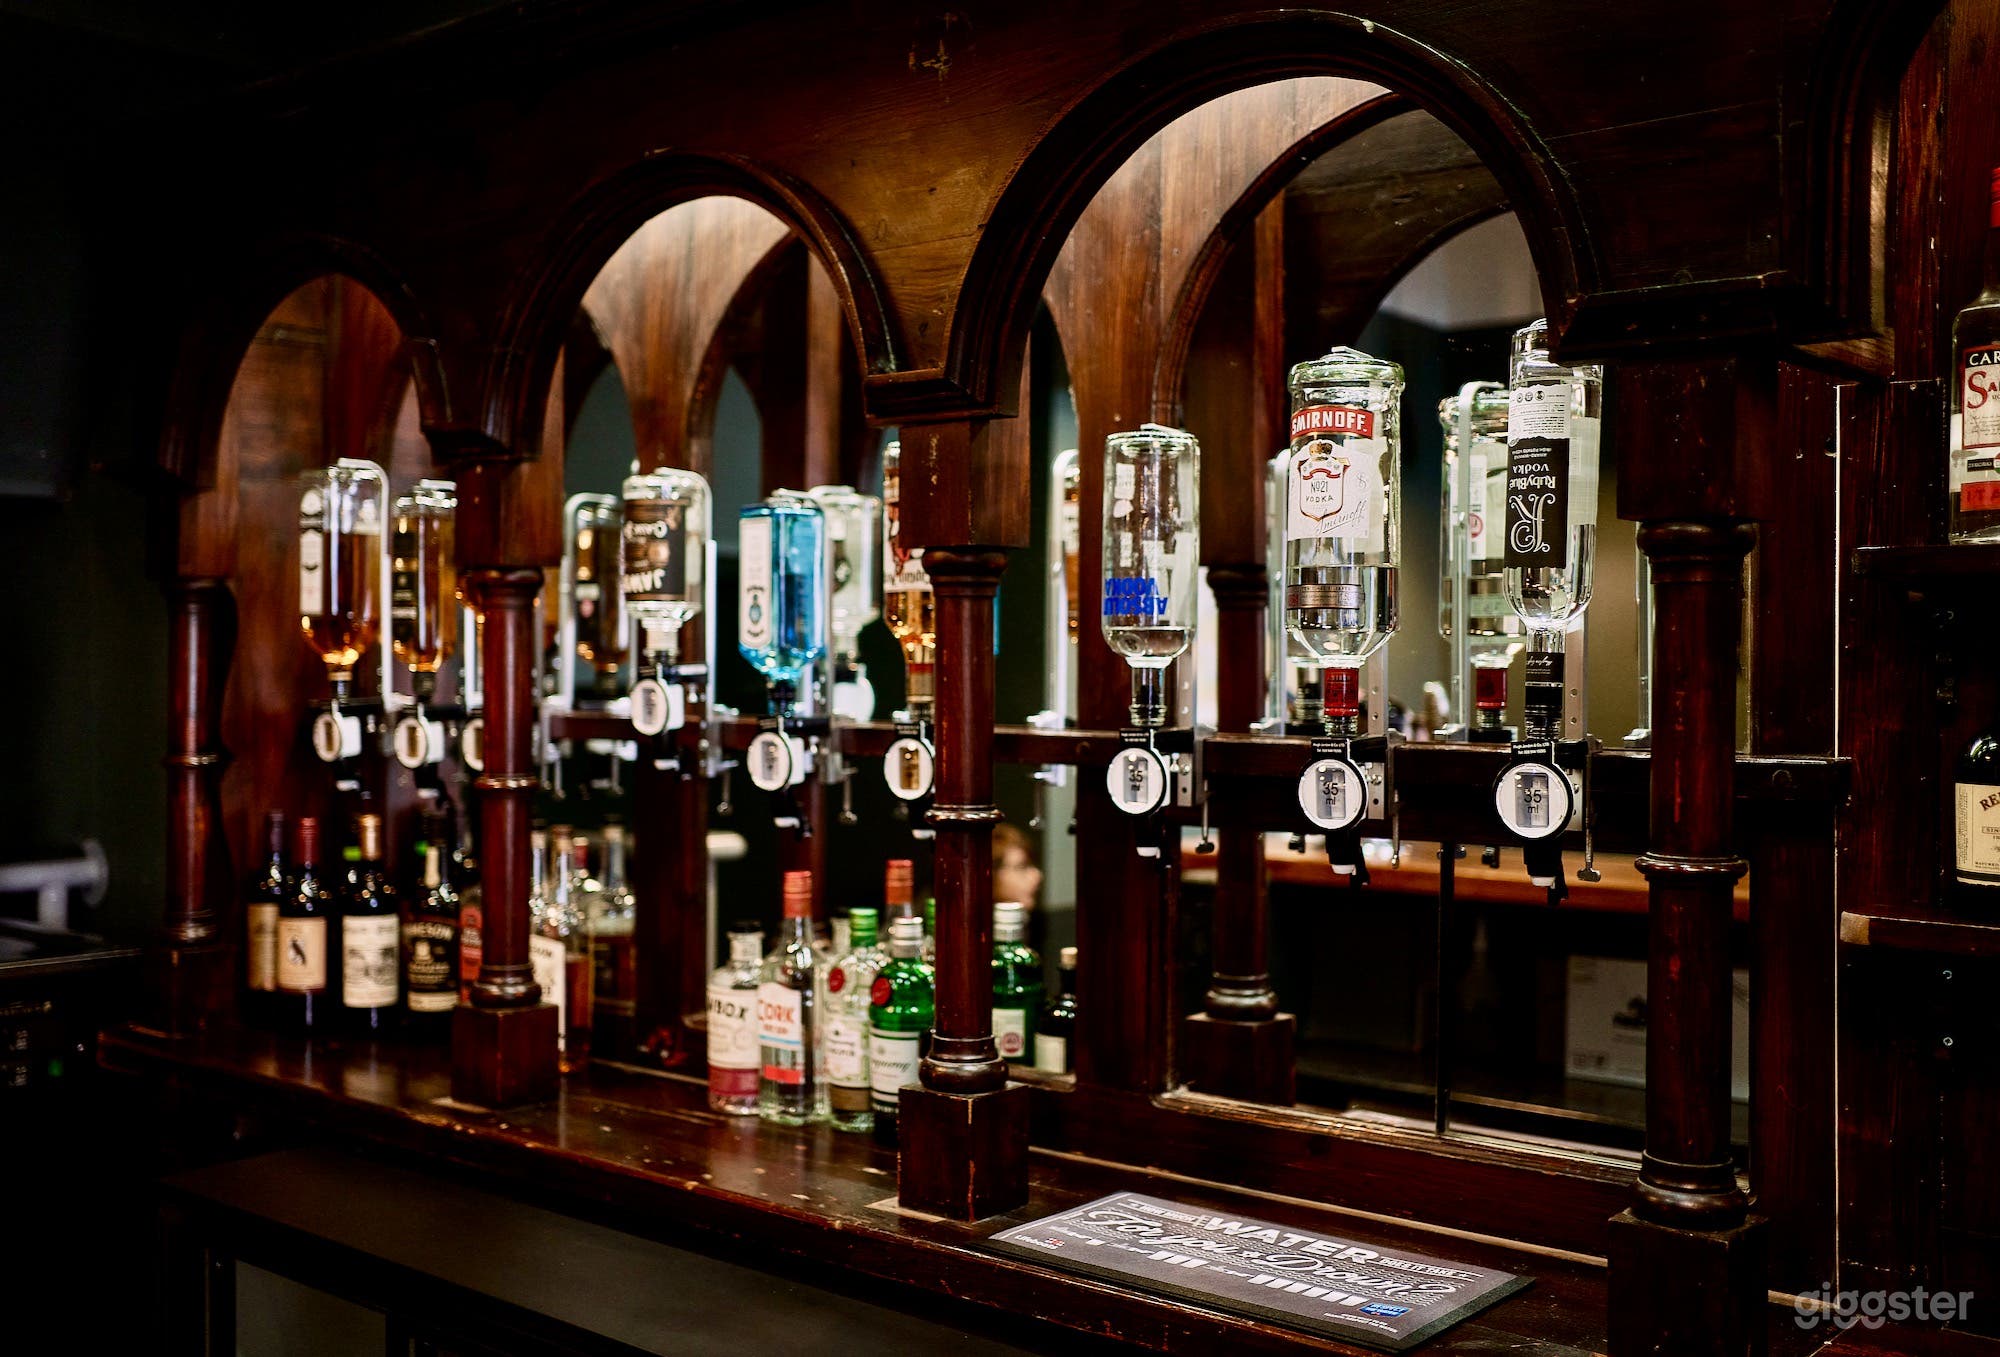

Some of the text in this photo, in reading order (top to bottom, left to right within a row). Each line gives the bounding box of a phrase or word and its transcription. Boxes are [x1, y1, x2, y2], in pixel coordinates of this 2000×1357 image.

[1966, 371, 2000, 409] SA
[1291, 410, 1366, 436] SMIRNOFF
[1508, 475, 1556, 490] RubyBlue
[1129, 769, 1144, 783] 35
[1322, 781, 1339, 796] 35
[1523, 787, 1542, 803] 35
[1325, 796, 1336, 805] ml
[1527, 804, 1539, 814] ml
[1979, 790, 2000, 812] RE
[757, 1000, 795, 1024] CORK
[1083, 1210, 1164, 1237] For
[1138, 1233, 1240, 1254] you
[1251, 1253, 1457, 1297] Drown?
[1203, 1217, 1379, 1265] WATER
[1379, 1258, 1409, 1270] DOES
[1422, 1265, 1457, 1278] TAKE
